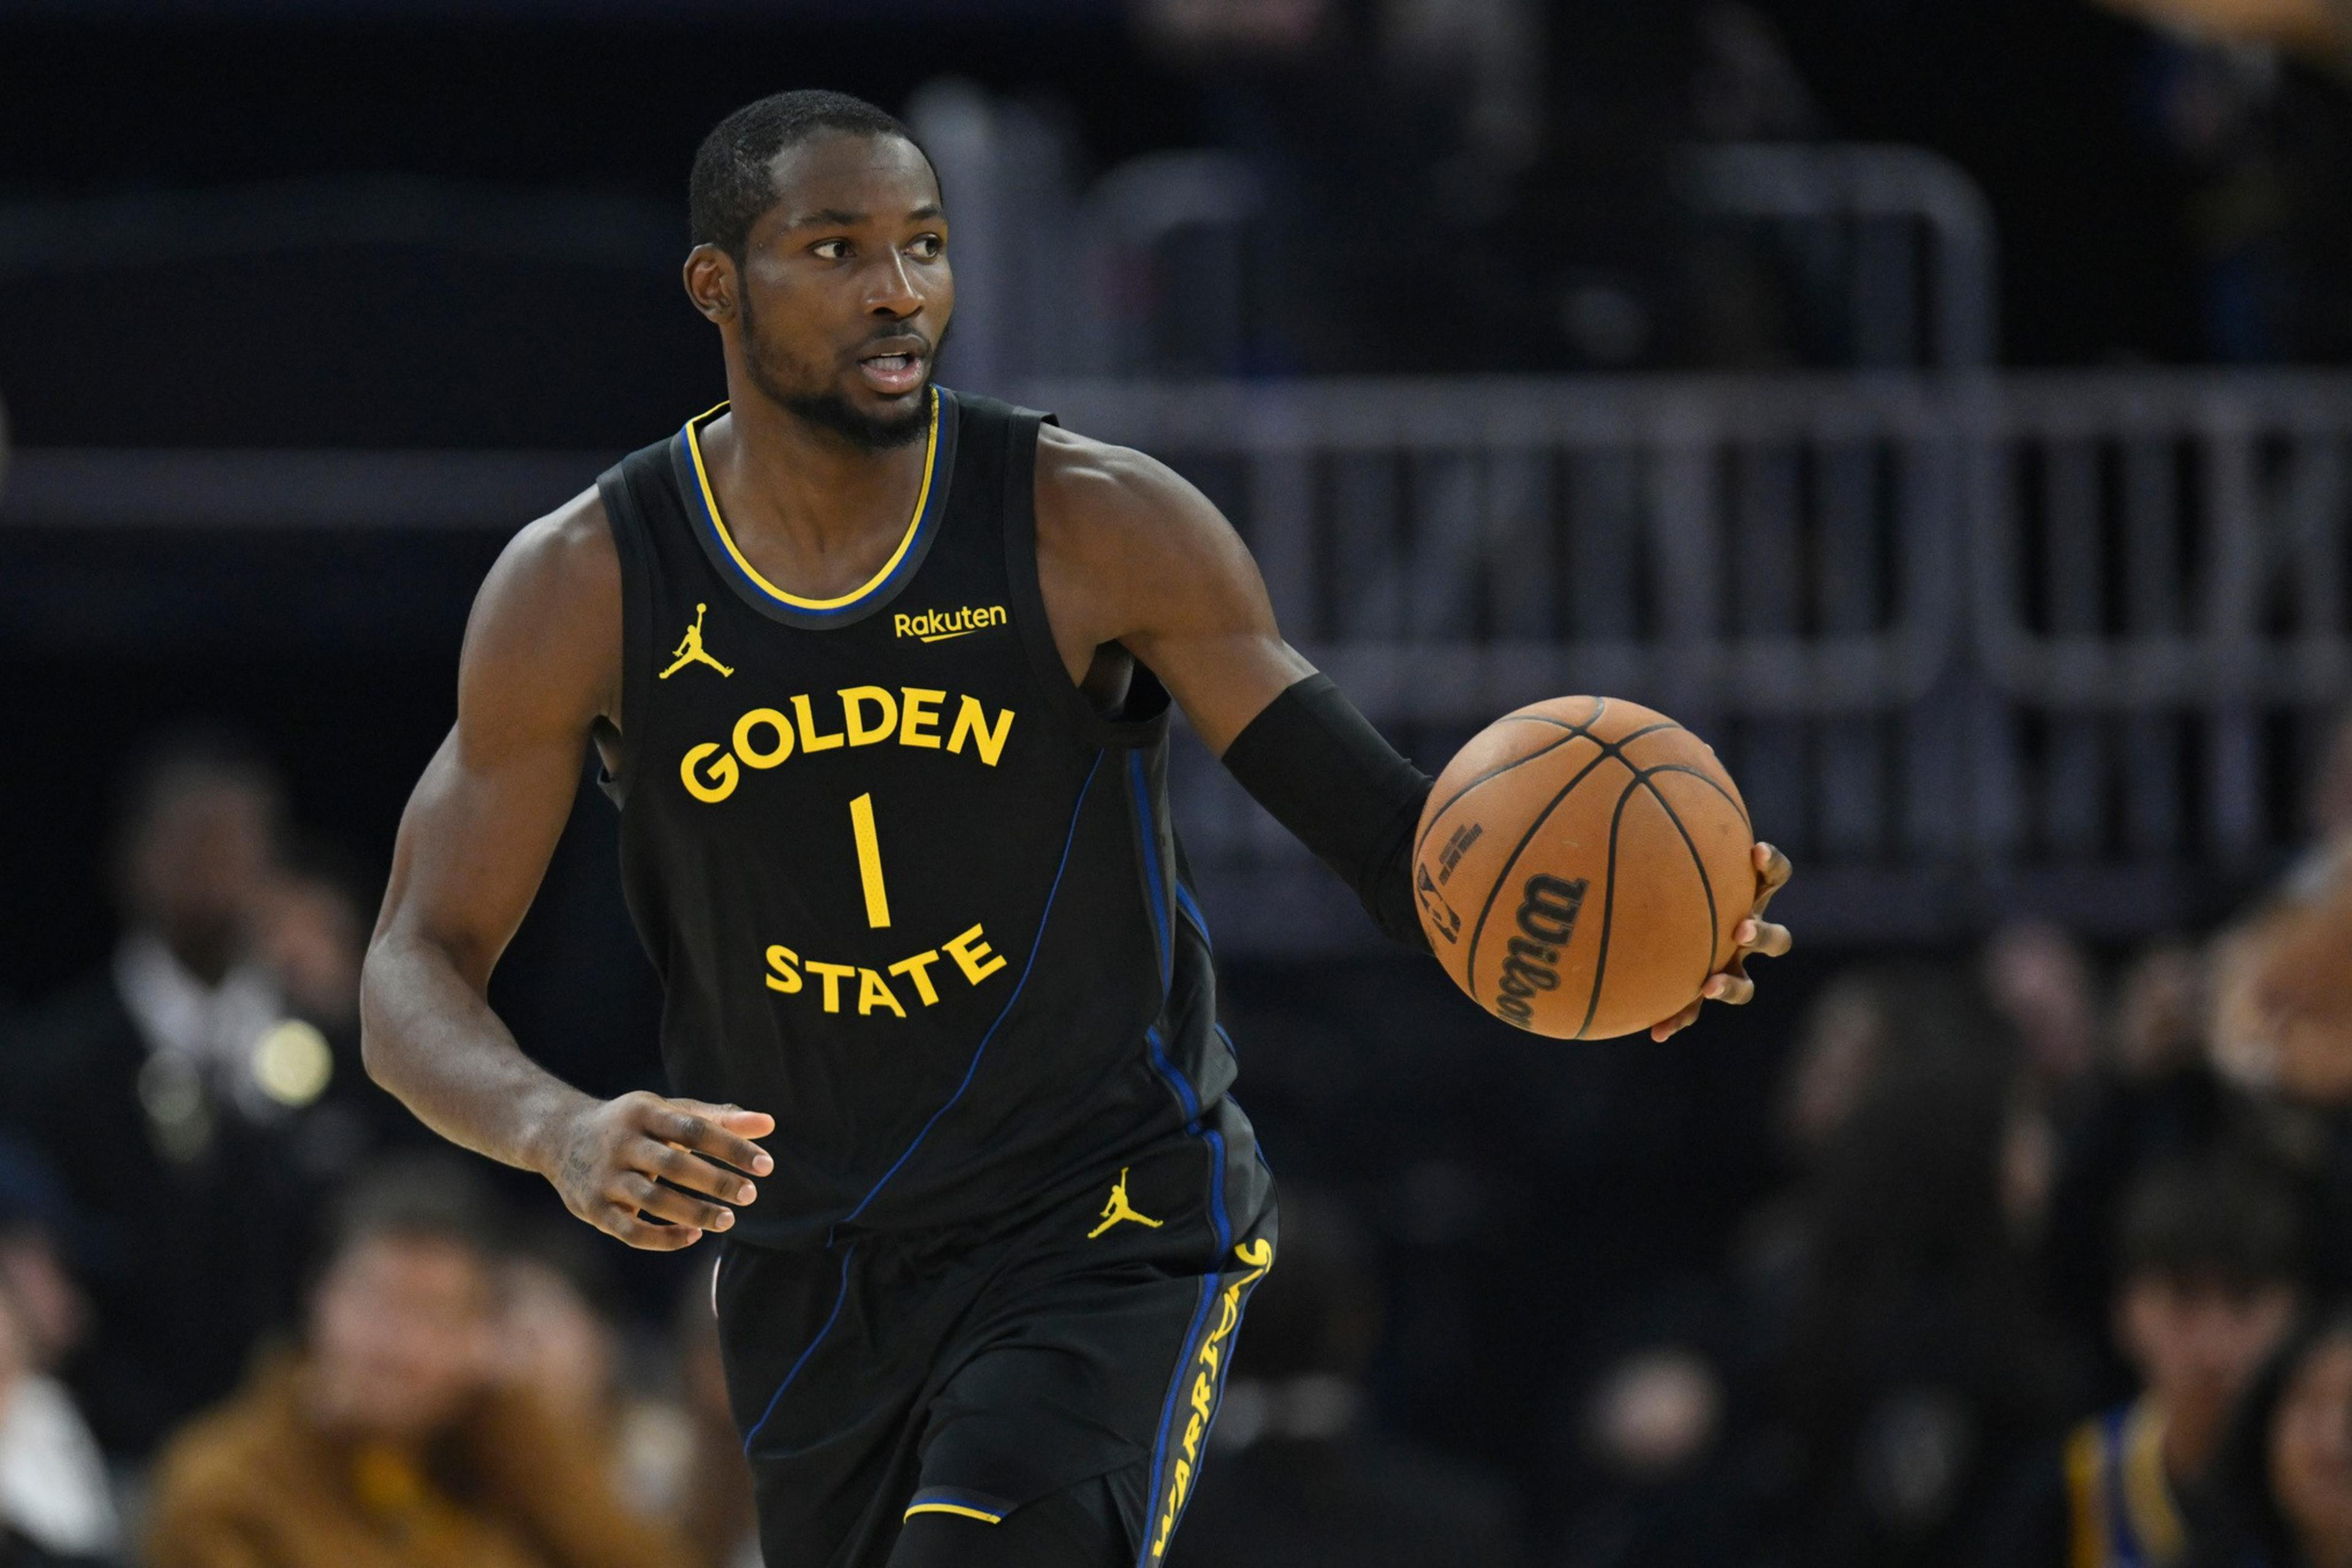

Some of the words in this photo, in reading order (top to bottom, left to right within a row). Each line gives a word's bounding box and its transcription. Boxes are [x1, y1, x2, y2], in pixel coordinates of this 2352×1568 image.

[894, 605, 1007, 638] Rakuten
[680, 685, 1015, 804] GOLDEN
[850, 793, 891, 929] 1
[766, 923, 1007, 1018] STATE
